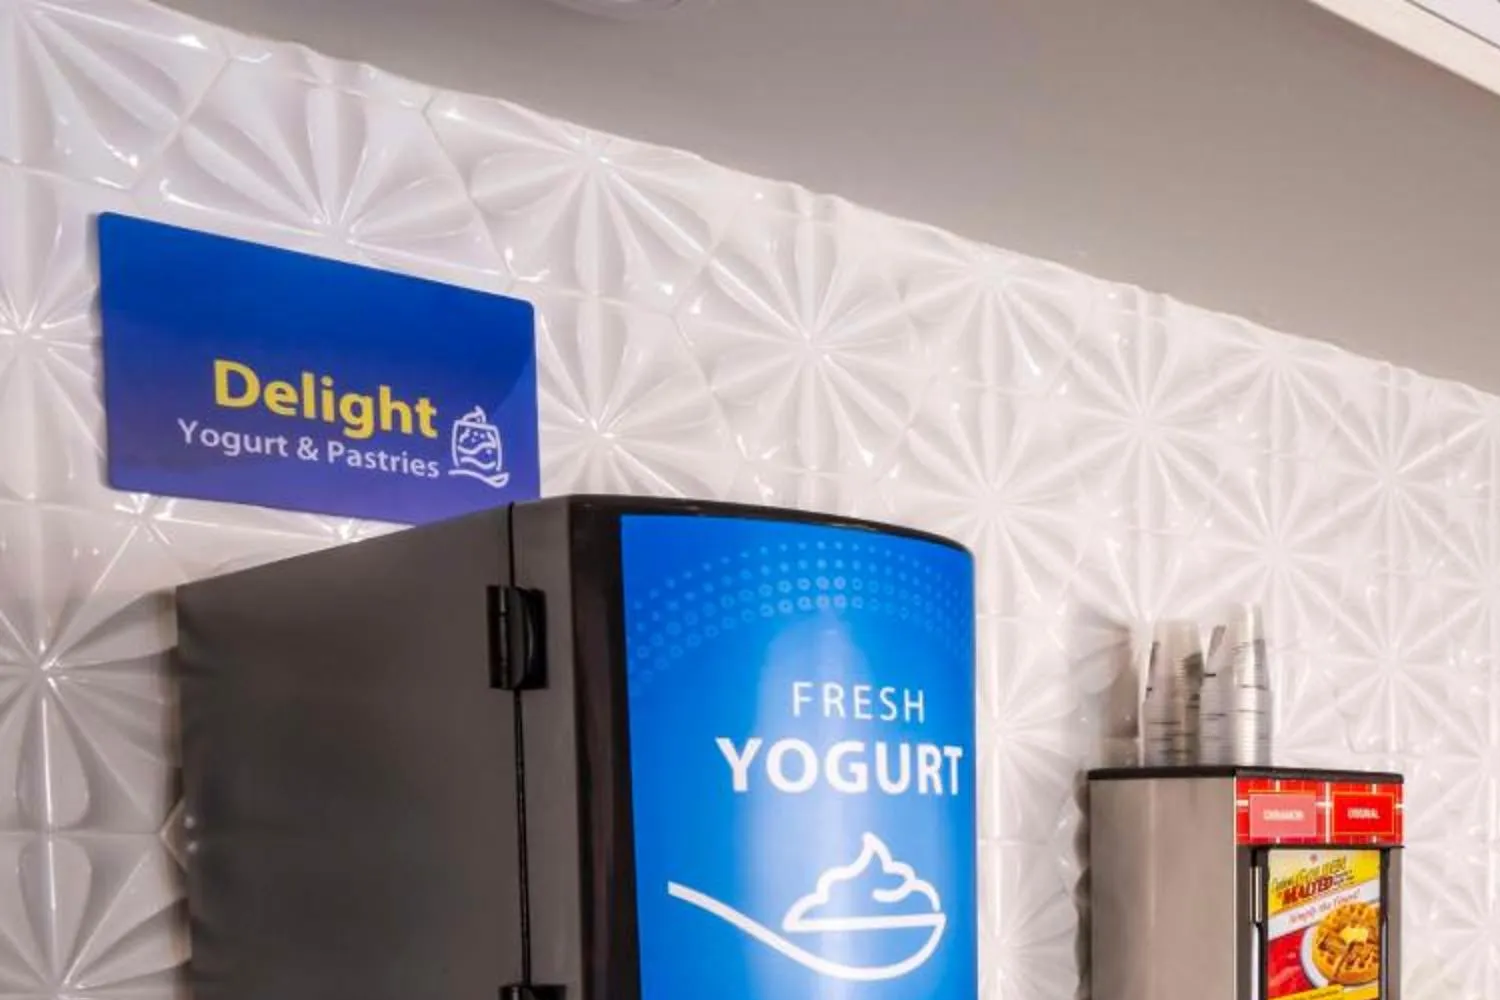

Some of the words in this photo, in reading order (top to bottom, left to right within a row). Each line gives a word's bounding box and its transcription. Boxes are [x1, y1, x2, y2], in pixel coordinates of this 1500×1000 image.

[214, 359, 438, 439] Delight
[178, 418, 288, 458] Yogurt
[297, 435, 319, 462] &
[328, 440, 440, 479] Pastries
[792, 681, 926, 723] FRESH
[715, 736, 963, 795] YOGURT
